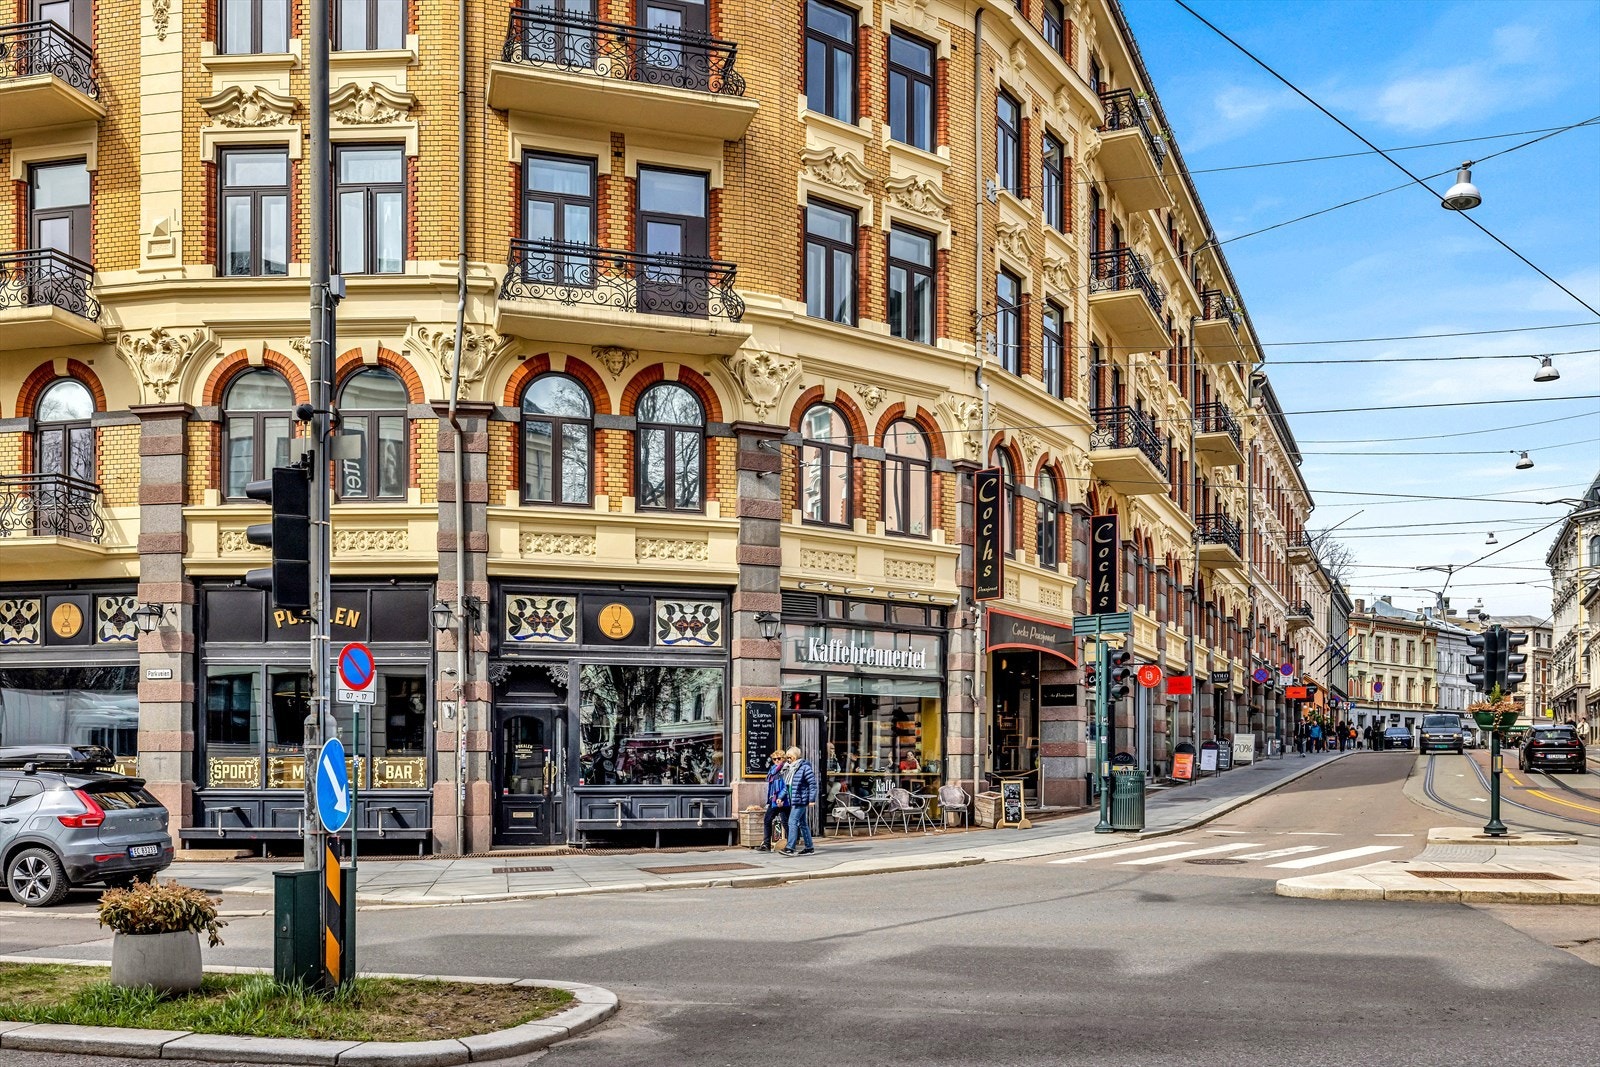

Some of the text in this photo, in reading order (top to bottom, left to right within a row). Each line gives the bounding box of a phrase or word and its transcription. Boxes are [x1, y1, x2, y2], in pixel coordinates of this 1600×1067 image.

[979, 477, 997, 577] Cochs
[1094, 522, 1114, 607] Cochs
[1029, 627, 1056, 643] Pensjonat
[808, 637, 926, 670] Kaffebrenneriet
[1234, 743, 1253, 753] 70%
[213, 764, 254, 780] SPORT
[385, 764, 413, 780] BAR
